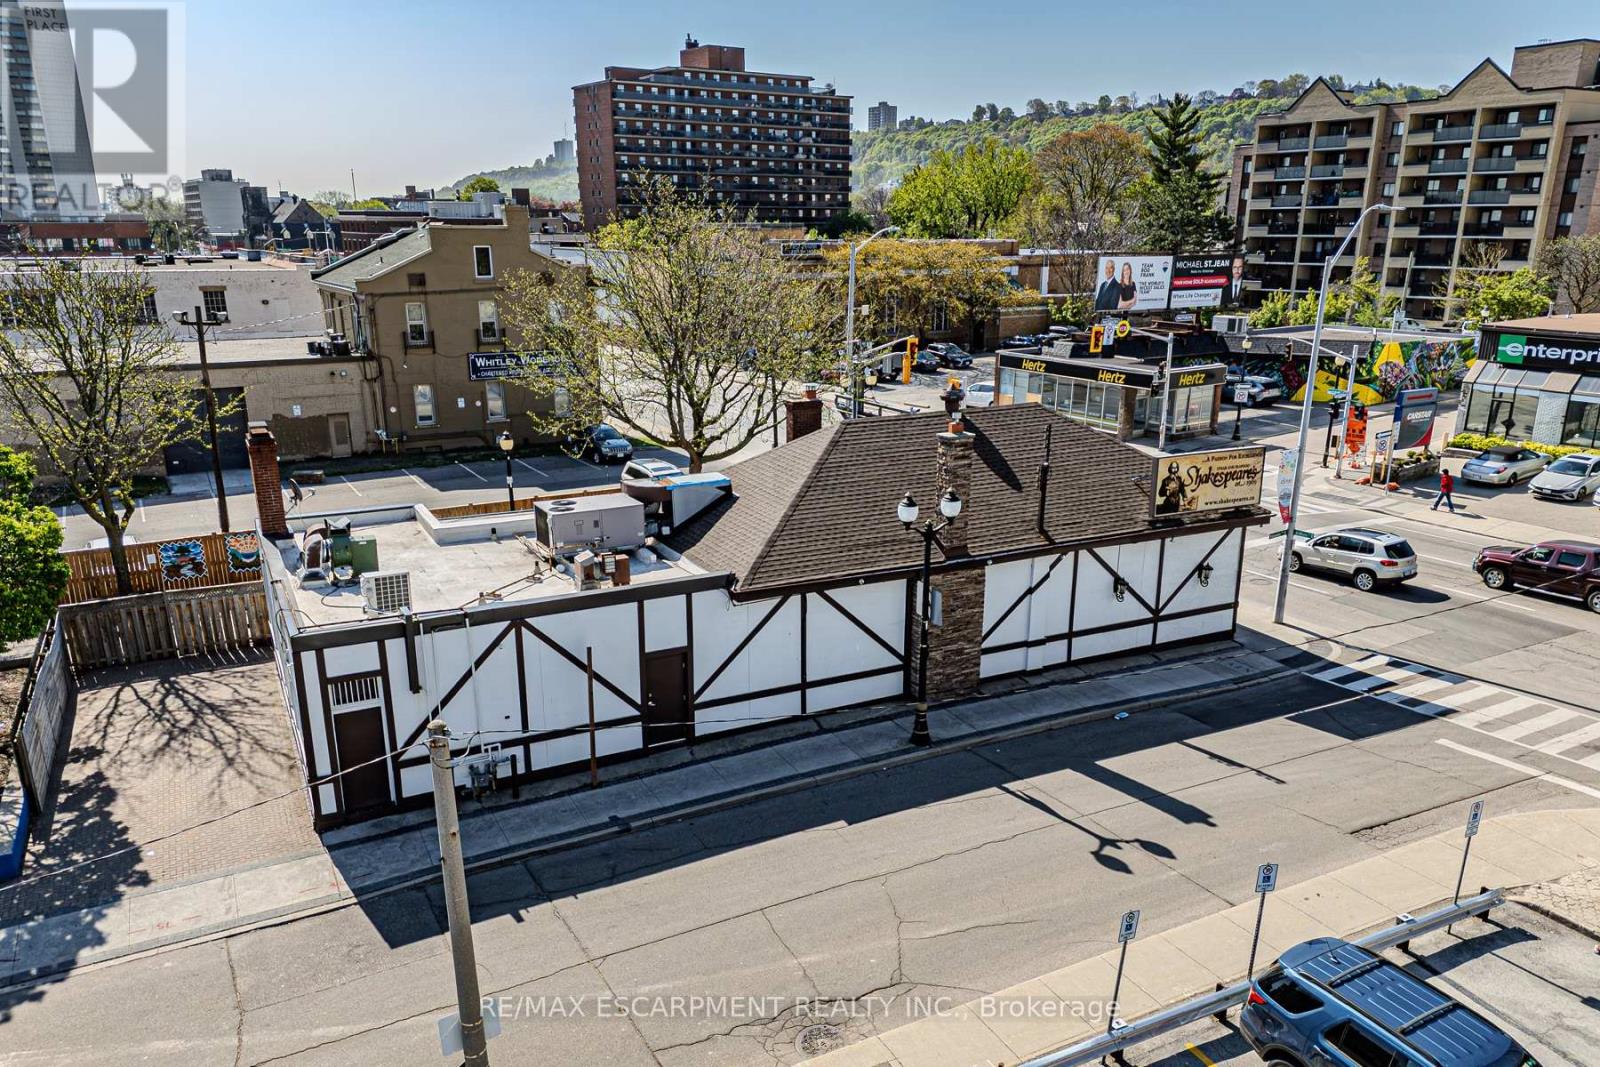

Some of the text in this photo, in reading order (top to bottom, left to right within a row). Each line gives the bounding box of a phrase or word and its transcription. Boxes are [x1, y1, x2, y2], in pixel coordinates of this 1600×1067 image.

[24, 6, 57, 19] FIRST
[26, 20, 66, 32] PLACE
[1176, 261, 1203, 269] MICHAEL
[1022, 359, 1046, 372] Hertz
[1098, 370, 1127, 385] Hertz
[1178, 372, 1206, 386] Hertz
